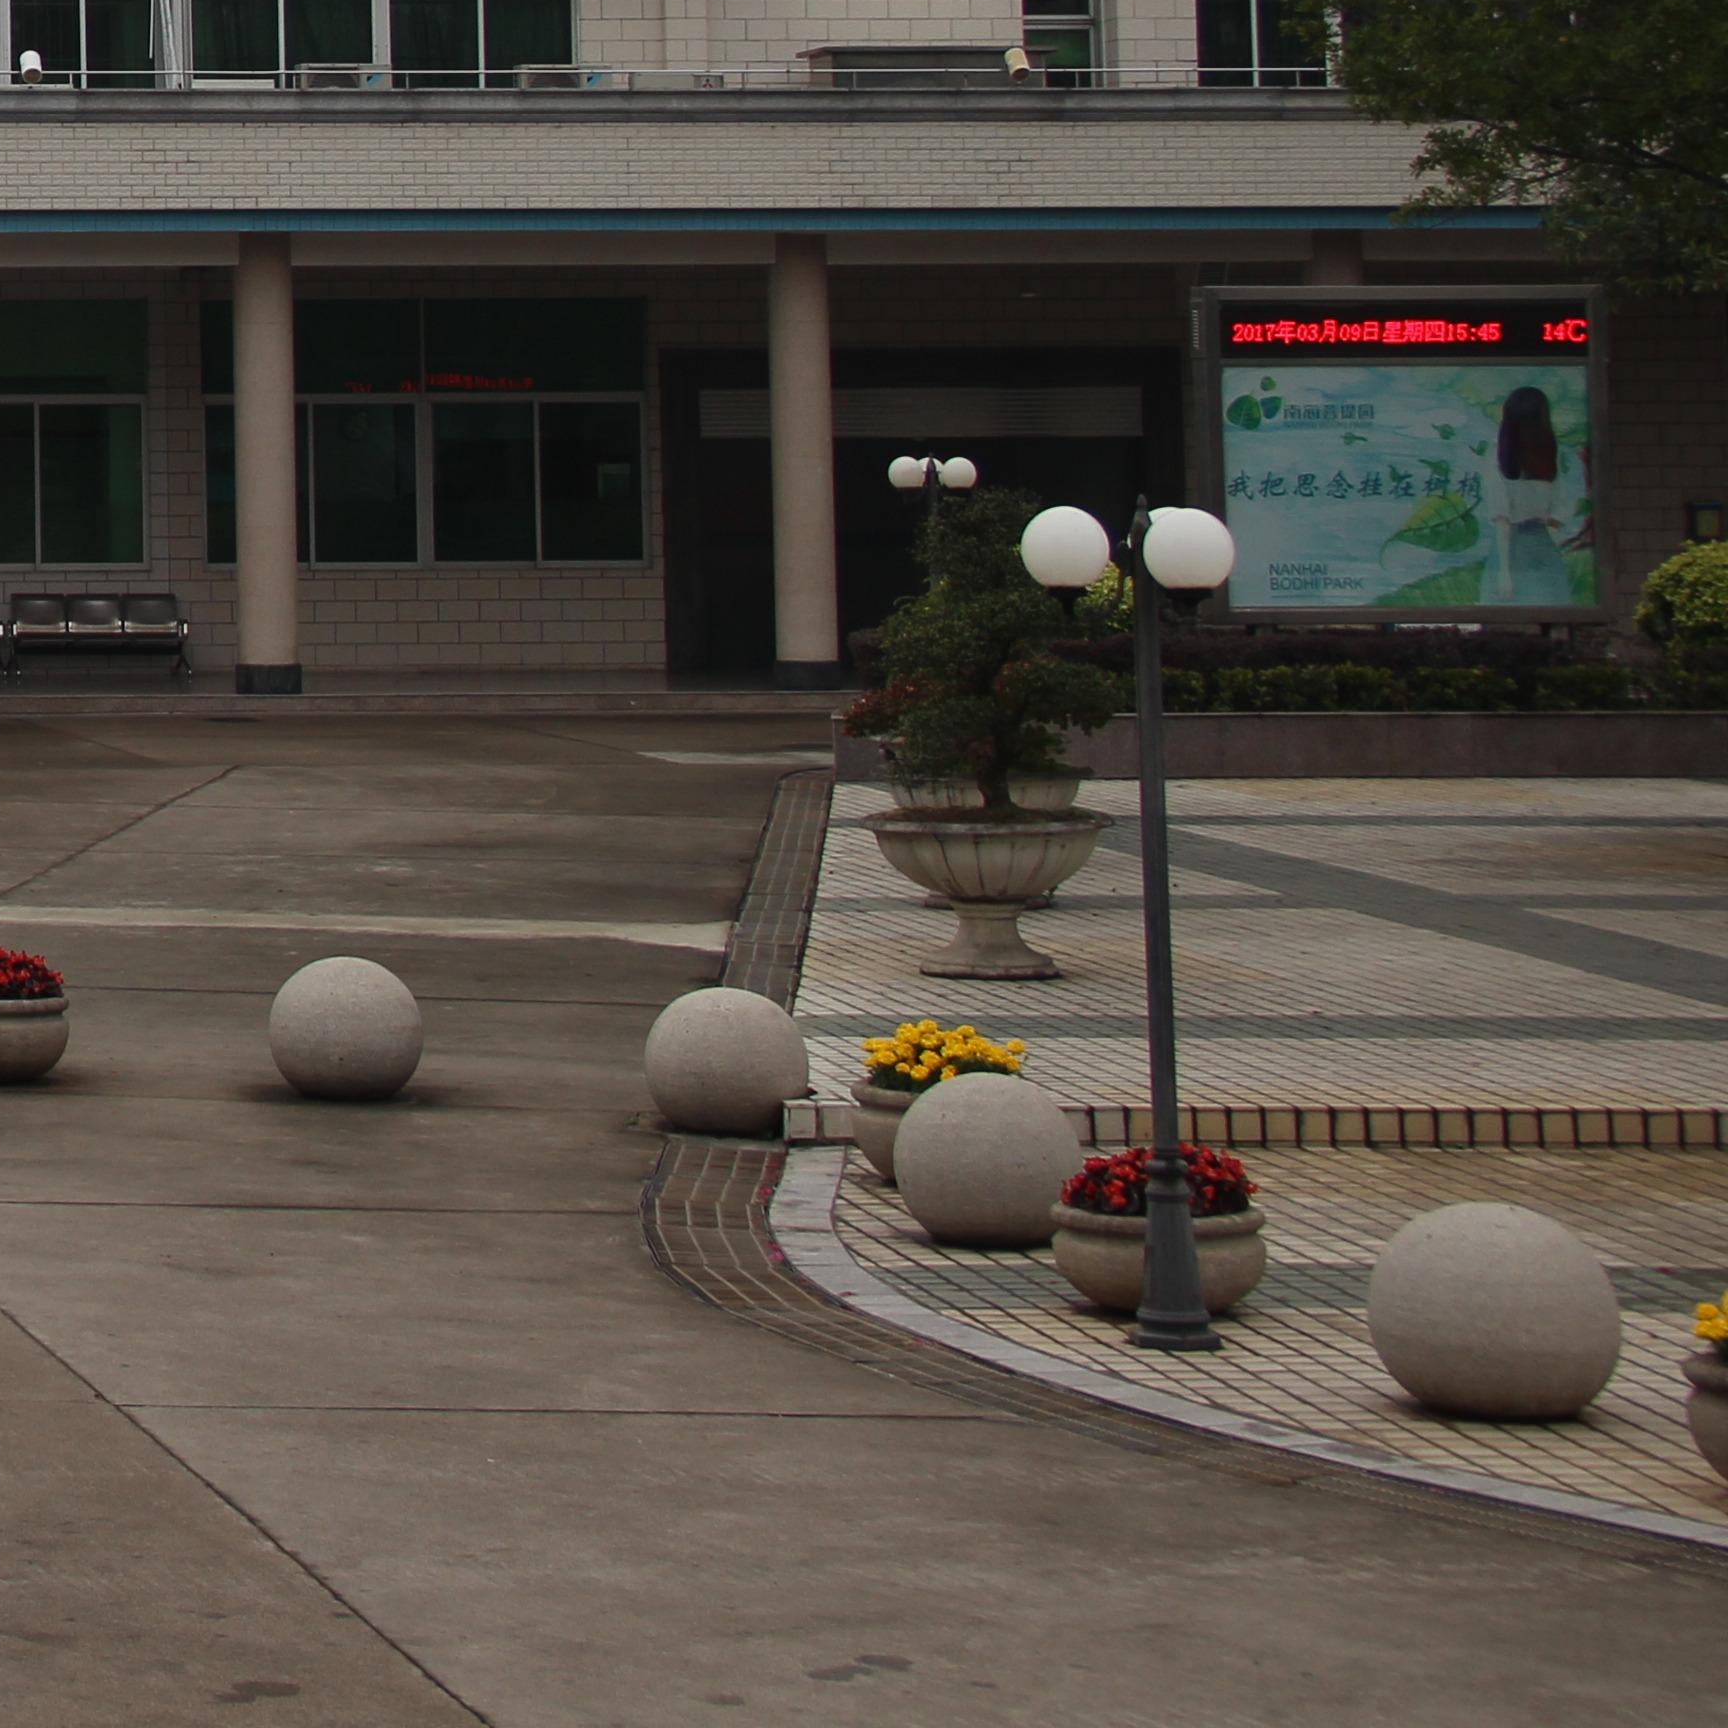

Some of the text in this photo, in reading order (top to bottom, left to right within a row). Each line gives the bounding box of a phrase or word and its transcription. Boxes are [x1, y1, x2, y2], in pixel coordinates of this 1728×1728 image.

[1268, 563, 1328, 576] NANHAI
[1269, 576, 1366, 591] BODHI PARK
